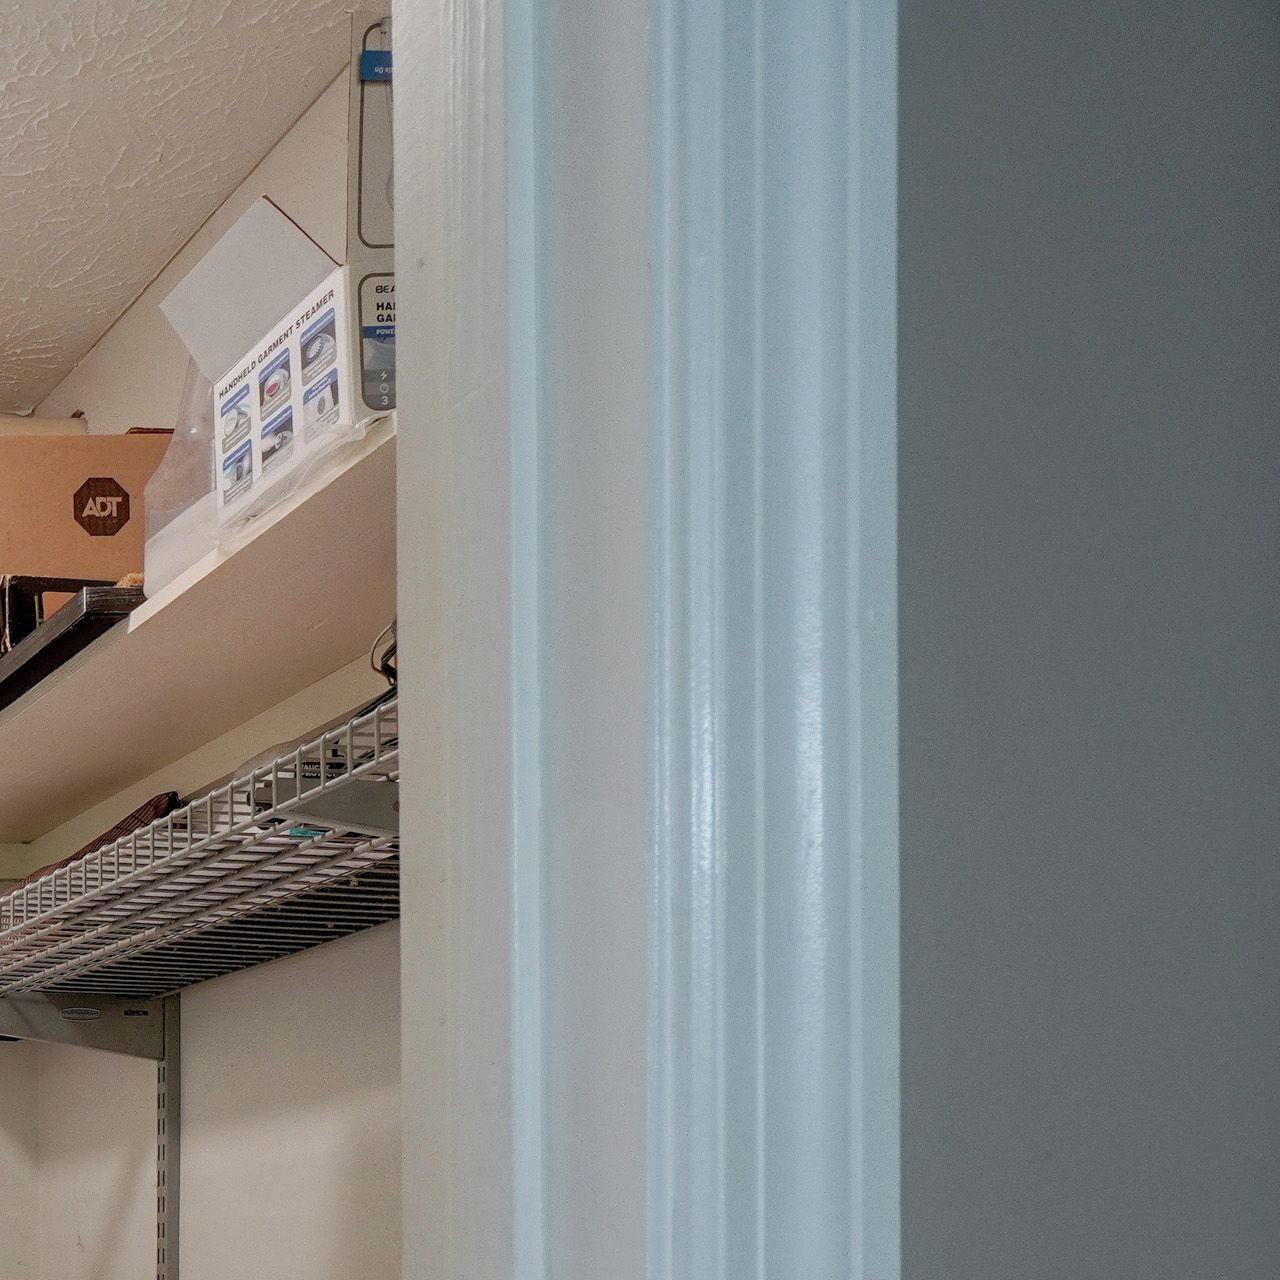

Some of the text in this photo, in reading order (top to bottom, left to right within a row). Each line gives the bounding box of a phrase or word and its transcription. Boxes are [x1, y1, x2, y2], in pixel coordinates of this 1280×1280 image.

[376, 302, 395, 311] HA
[376, 313, 395, 323] GA
[218, 360, 256, 400] HANDHELD
[258, 325, 294, 364] GARMENT
[295, 289, 335, 330] STEAMER
[381, 396, 389, 405] 3
[81, 496, 123, 519] ADT
